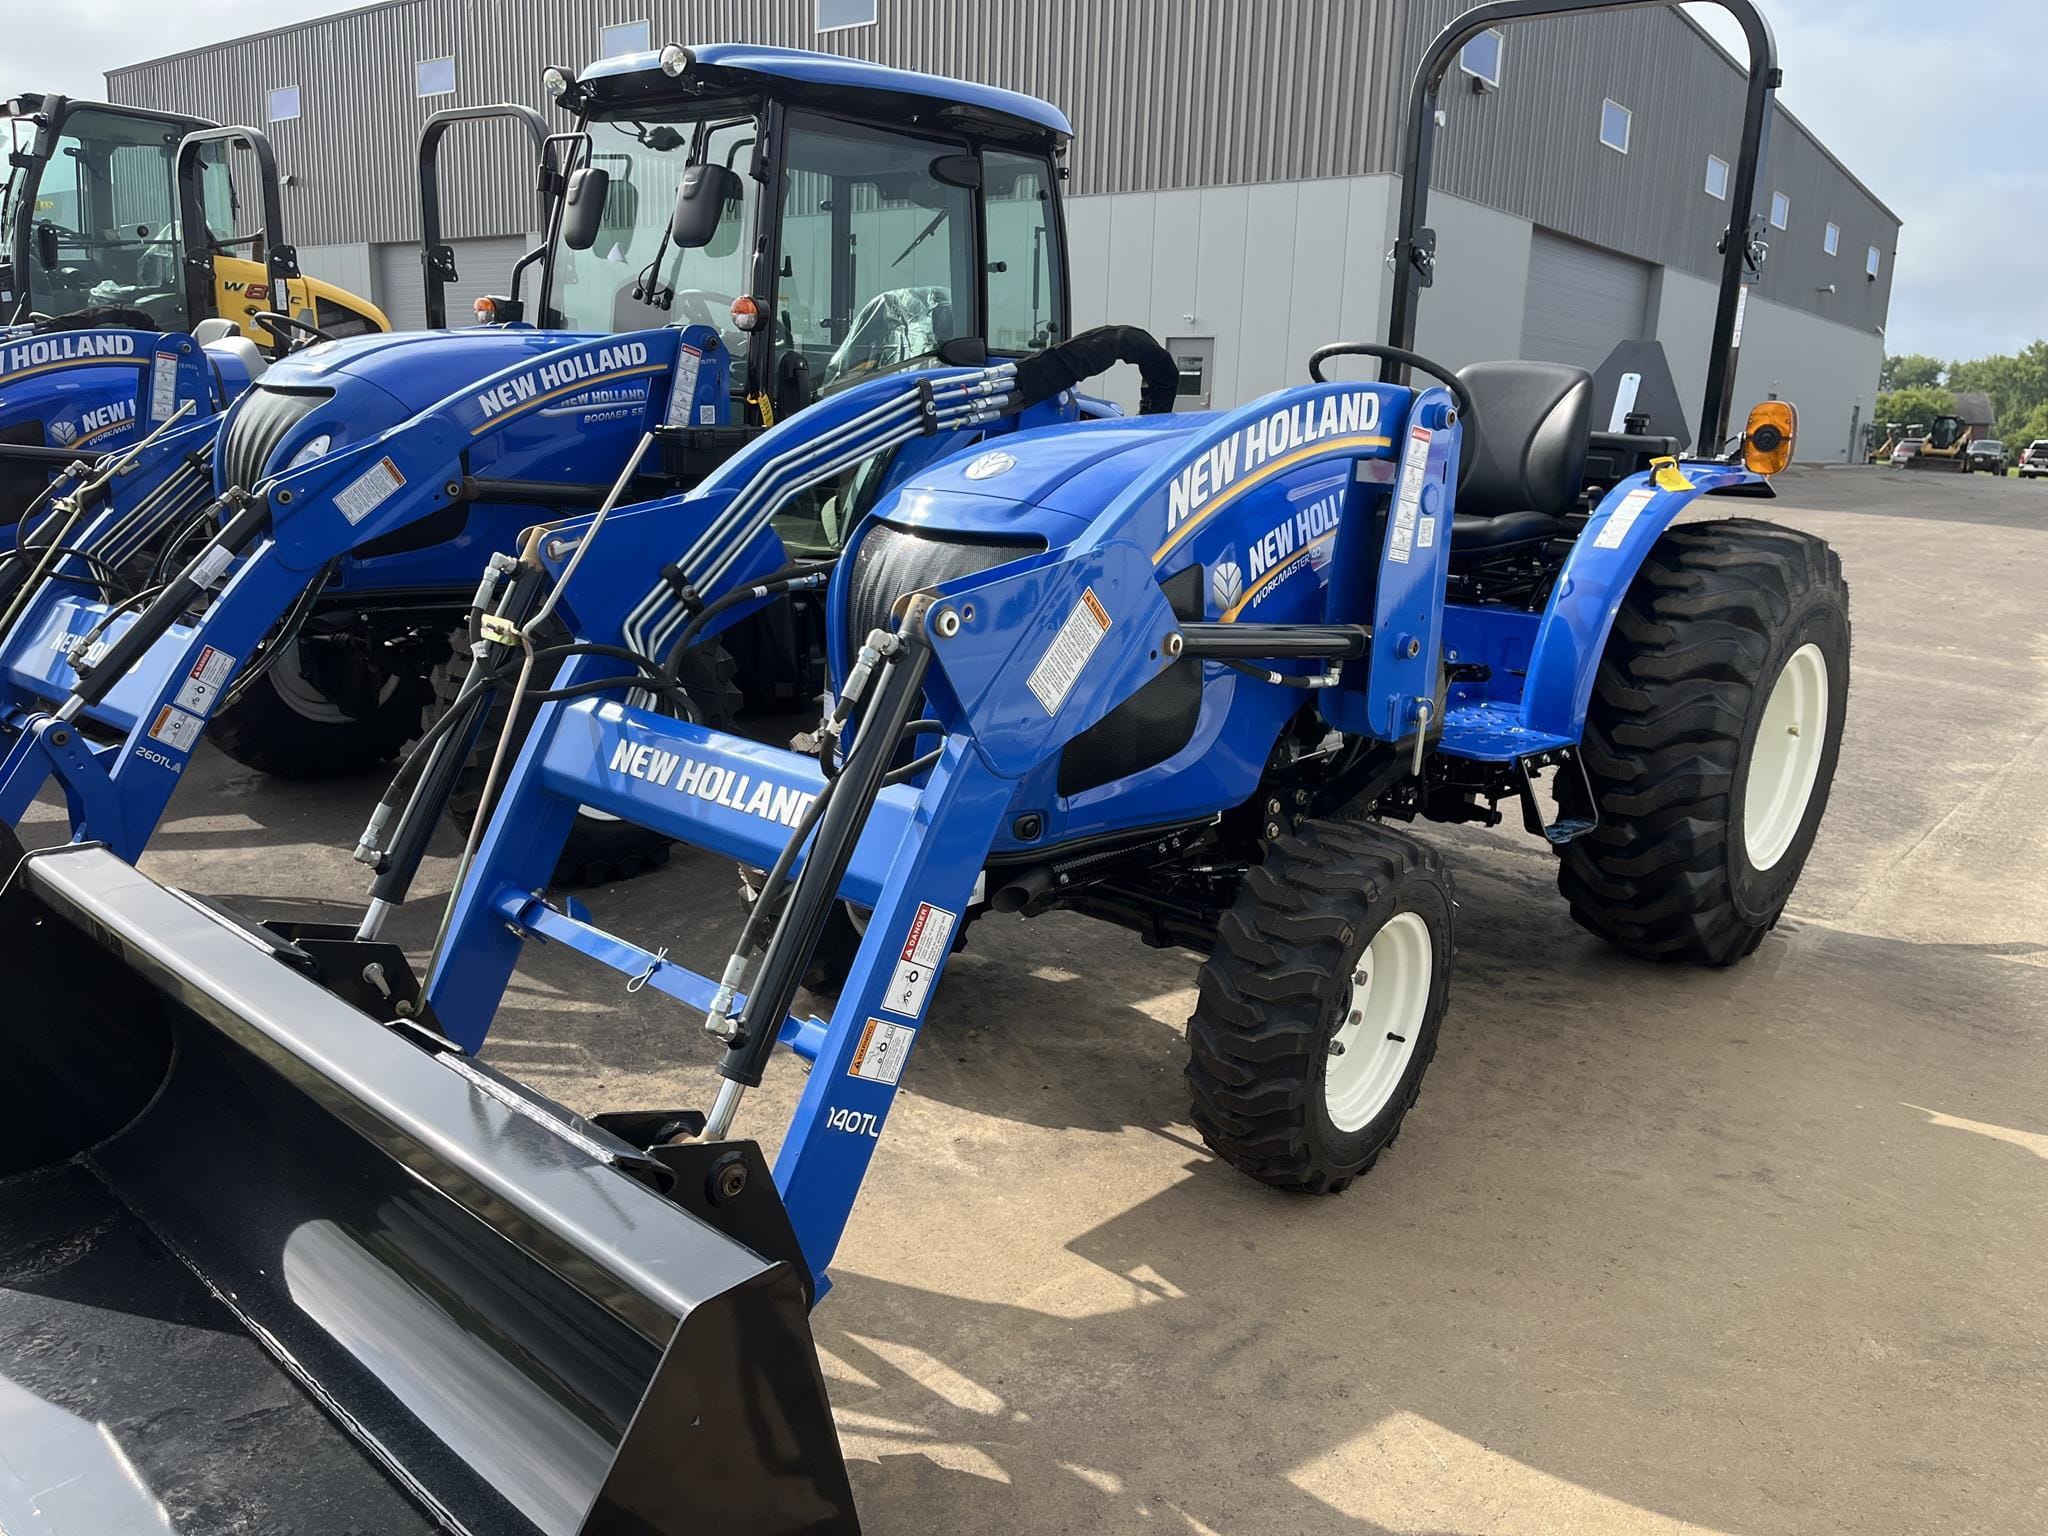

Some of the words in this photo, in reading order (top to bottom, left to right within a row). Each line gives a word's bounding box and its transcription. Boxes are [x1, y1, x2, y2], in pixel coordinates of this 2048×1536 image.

[11, 335, 134, 370] HOLLAND
[478, 372, 537, 418] NEW
[538, 342, 647, 391] HOLLAND
[591, 389, 645, 404] HOLLAND
[82, 401, 125, 433] NEW
[1167, 431, 1240, 533] NEW
[1244, 392, 1380, 472] HOLLAND
[1249, 518, 1293, 582] NEW
[1253, 554, 1311, 608] WORKMASTER
[609, 738, 680, 786] NEW
[908, 907, 929, 947] DANGER
[826, 1106, 879, 1138] 140TL
